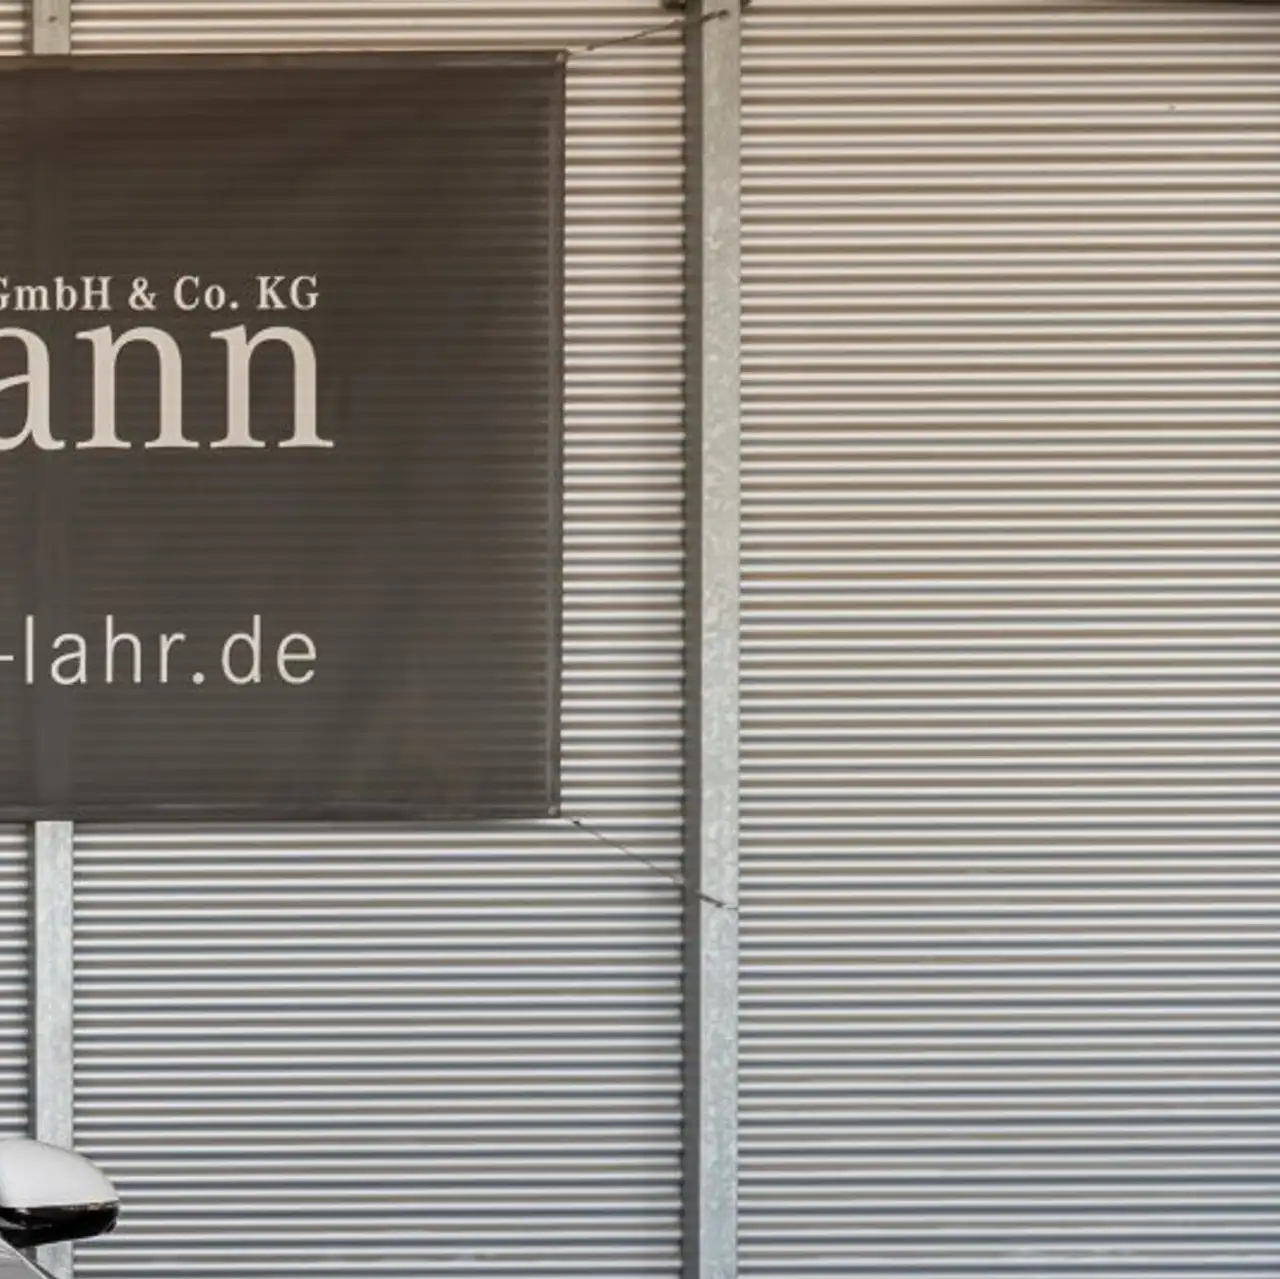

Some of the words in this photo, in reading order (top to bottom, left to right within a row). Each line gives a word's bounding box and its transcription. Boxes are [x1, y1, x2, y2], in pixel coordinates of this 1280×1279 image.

[127, 275, 158, 312] &
[172, 275, 240, 312] Co.
[256, 274, 321, 311] KG
